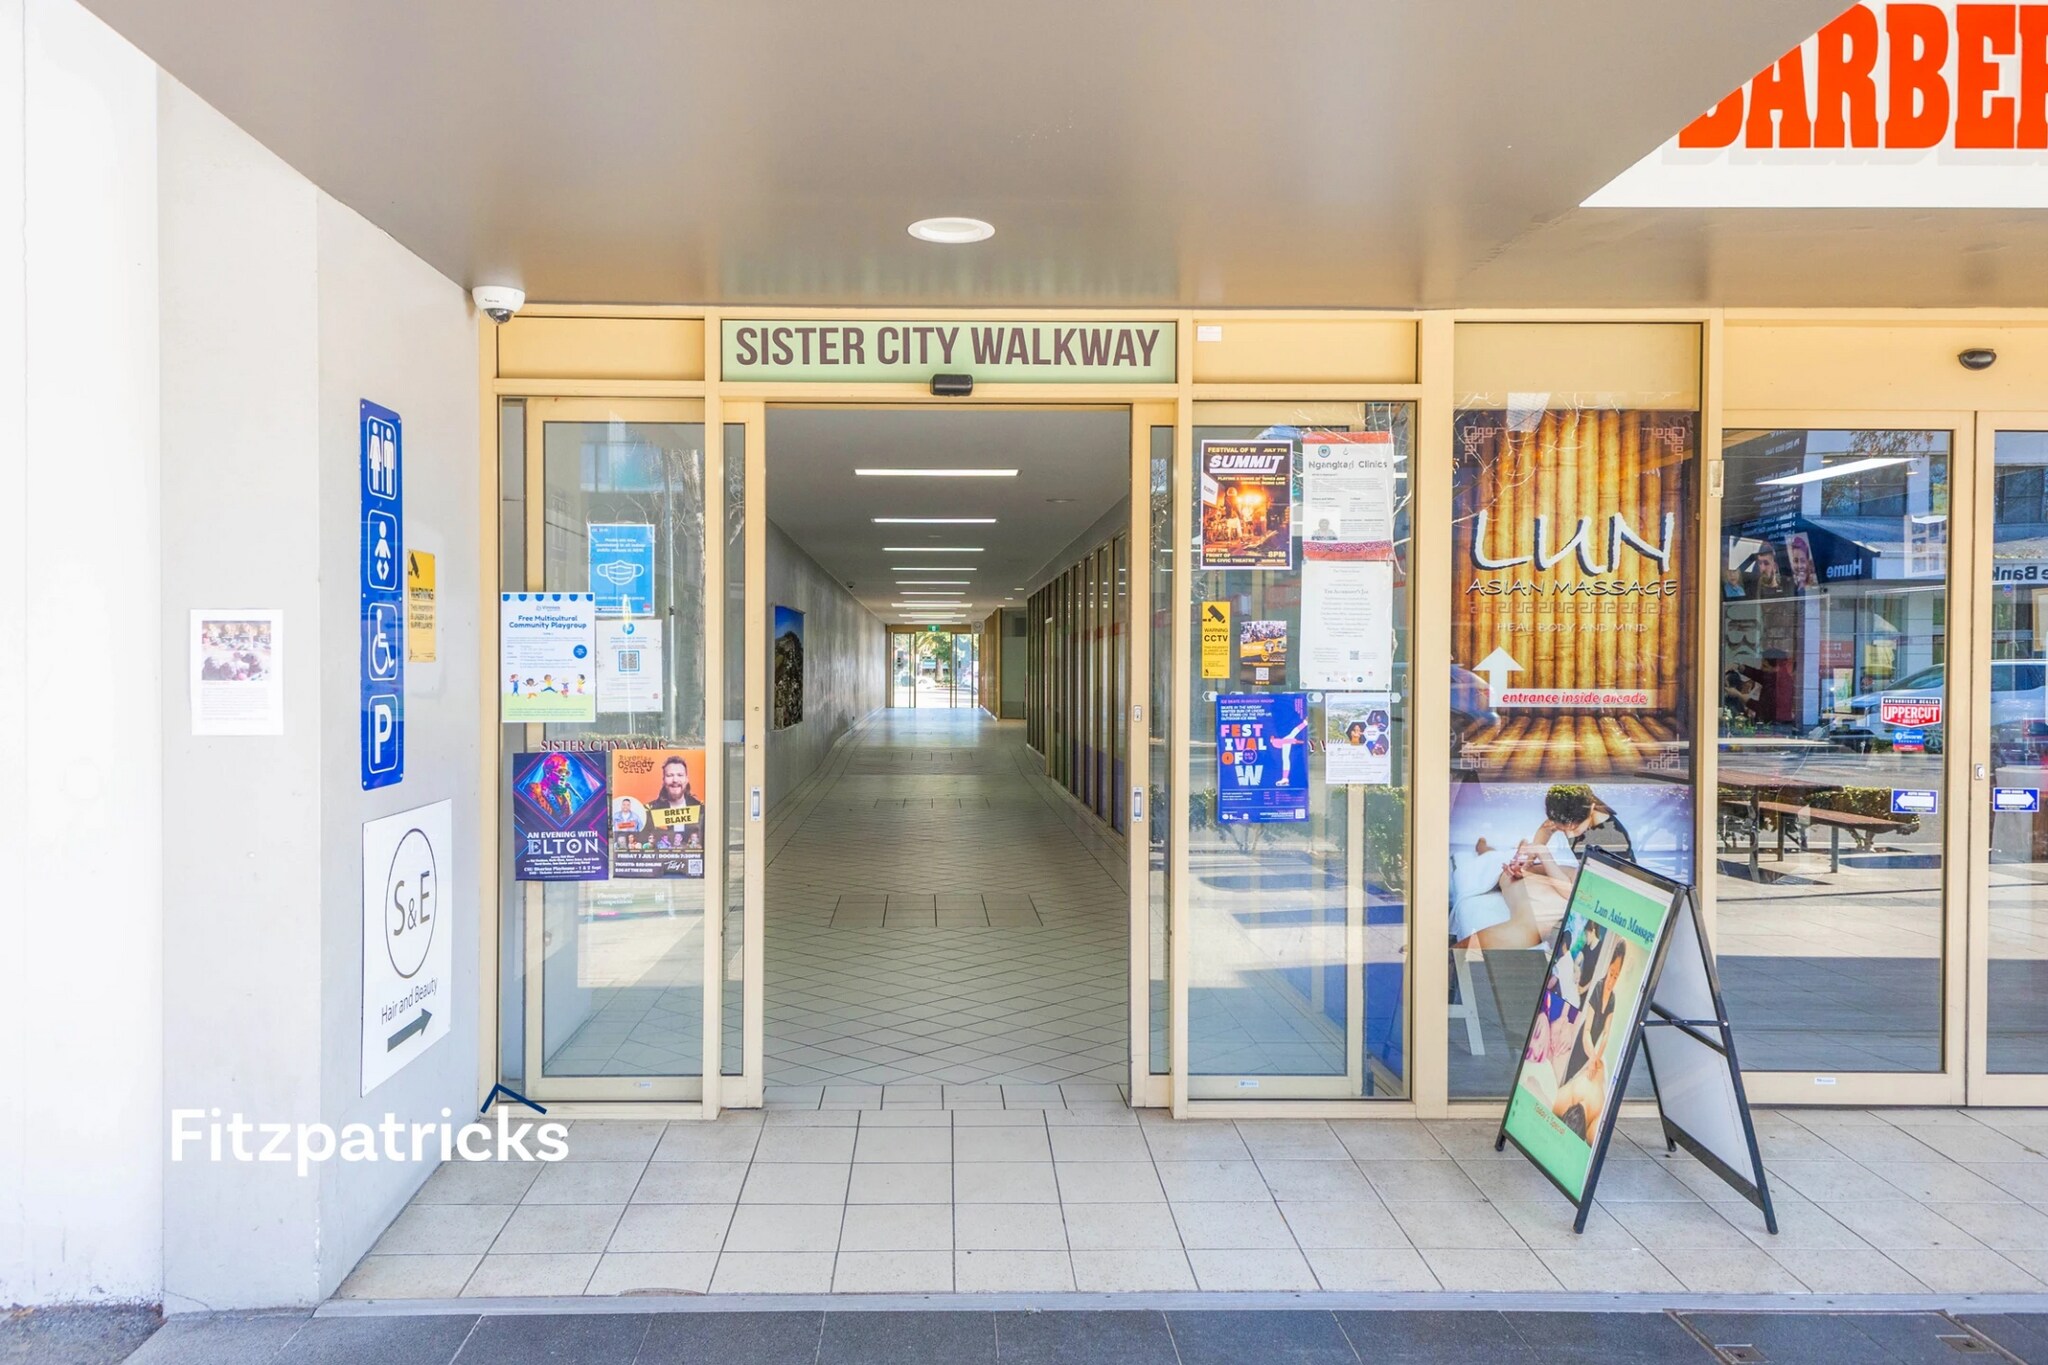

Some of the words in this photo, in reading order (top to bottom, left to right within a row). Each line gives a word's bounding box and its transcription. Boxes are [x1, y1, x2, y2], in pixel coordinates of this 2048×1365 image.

[736, 327, 866, 366] SISTER
[877, 326, 960, 366] CITY
[970, 327, 1160, 367] WALKWAY
[1209, 455, 1284, 473] SUMMIT
[1358, 460, 1387, 468] Clinics
[1471, 511, 1675, 576] LUN
[1466, 579, 1544, 596] ASIAN
[1550, 579, 1678, 600] MASSAGE
[1497, 623, 1534, 632] HEAL
[1538, 623, 1575, 632] BODY
[1580, 623, 1609, 632] AND
[1614, 623, 1648, 632] MIND
[1502, 694, 1558, 704] entrance
[1562, 692, 1599, 704] inside
[1603, 693, 1647, 704] arcade
[1884, 706, 1938, 721] UPPERCUT
[374, 704, 392, 764] P
[1221, 724, 1263, 737] FEST
[540, 740, 585, 752] SISTER
[589, 740, 622, 752] CITY
[624, 740, 666, 750] WALK
[1225, 738, 1267, 750] IVAL
[1221, 753, 1243, 764] OF
[618, 760, 655, 772] Comedy
[1235, 765, 1263, 786] W
[664, 808, 690, 816] BRETT
[665, 816, 691, 824] BLAKE
[527, 839, 598, 854] ELTON
[1594, 900, 1608, 918] Lun
[1609, 908, 1627, 928] Asian
[1627, 917, 1656, 943] Massage
[381, 1003, 398, 1026] Hair
[399, 989, 413, 1014] and
[414, 977, 438, 1003] Beauty
